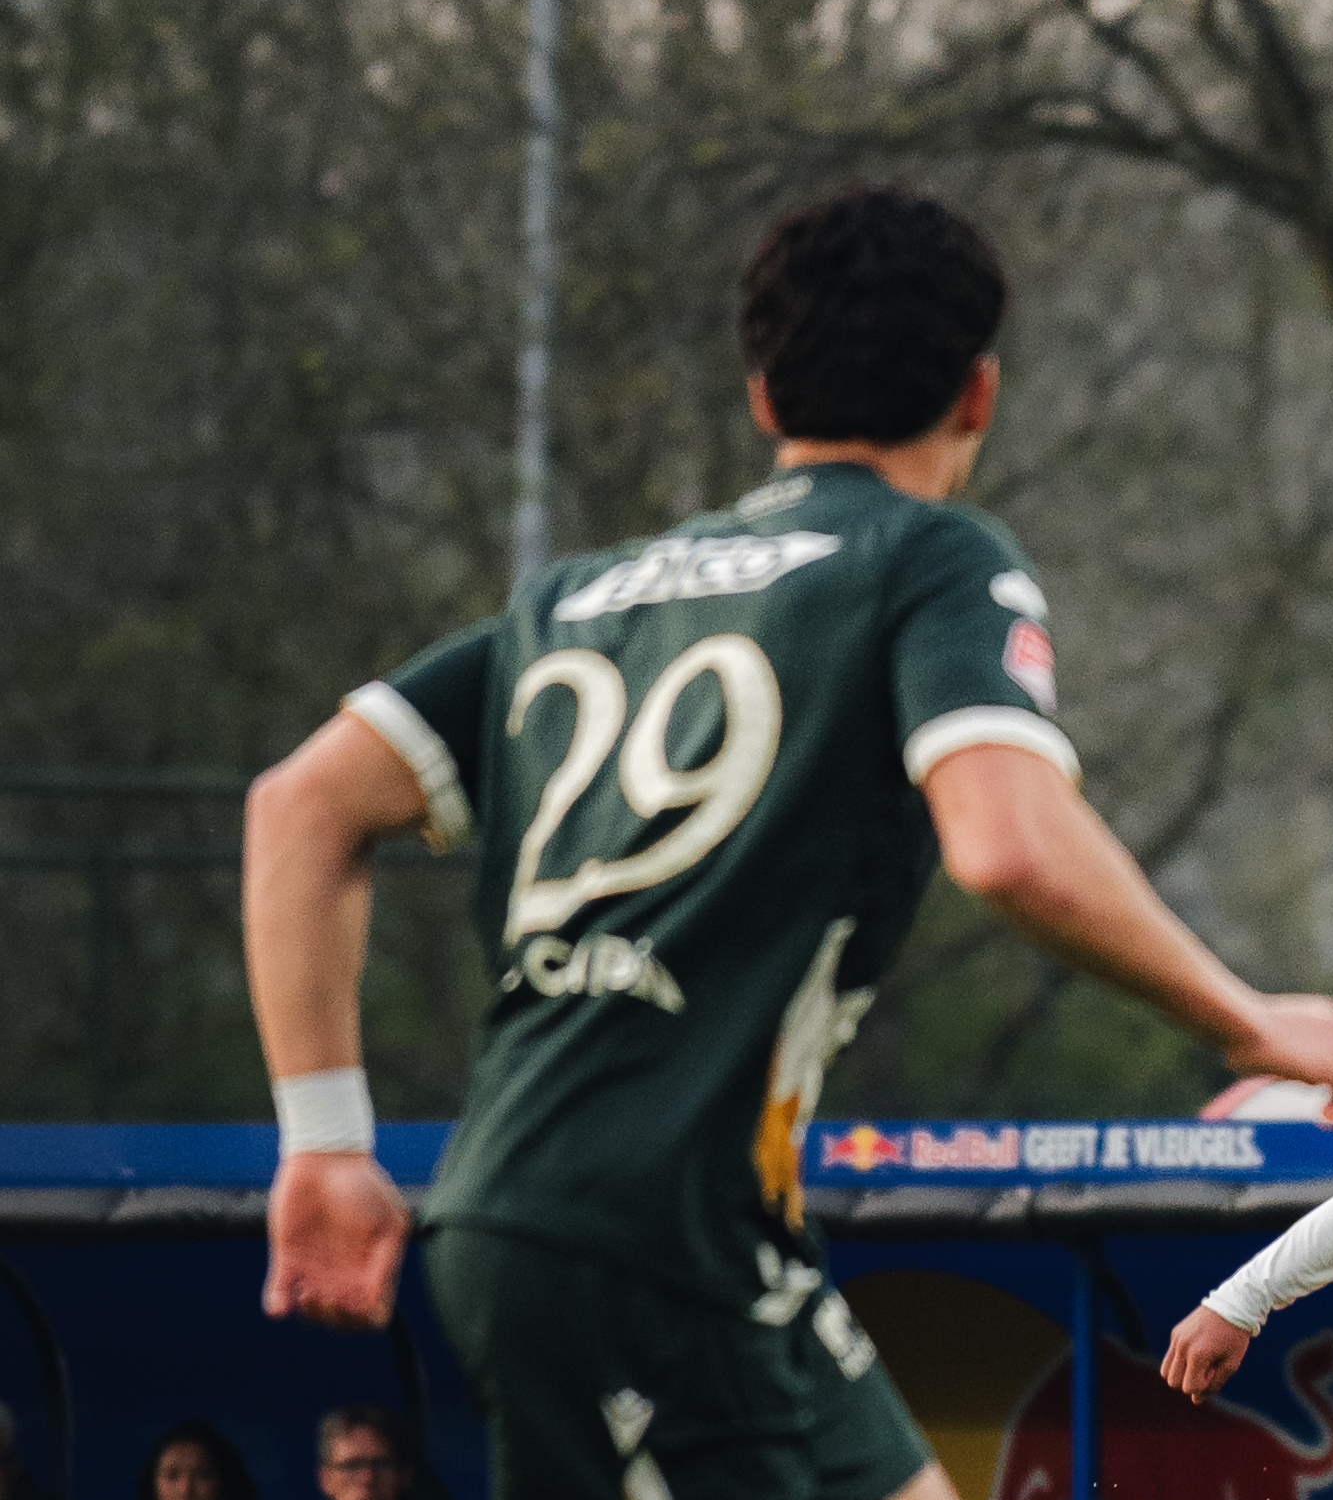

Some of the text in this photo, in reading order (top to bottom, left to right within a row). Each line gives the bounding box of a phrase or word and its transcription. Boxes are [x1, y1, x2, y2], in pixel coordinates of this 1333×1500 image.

[505, 633, 783, 947] 29
[1025, 1125, 1099, 1169] GEEFT
[1103, 1125, 1131, 1168] JE
